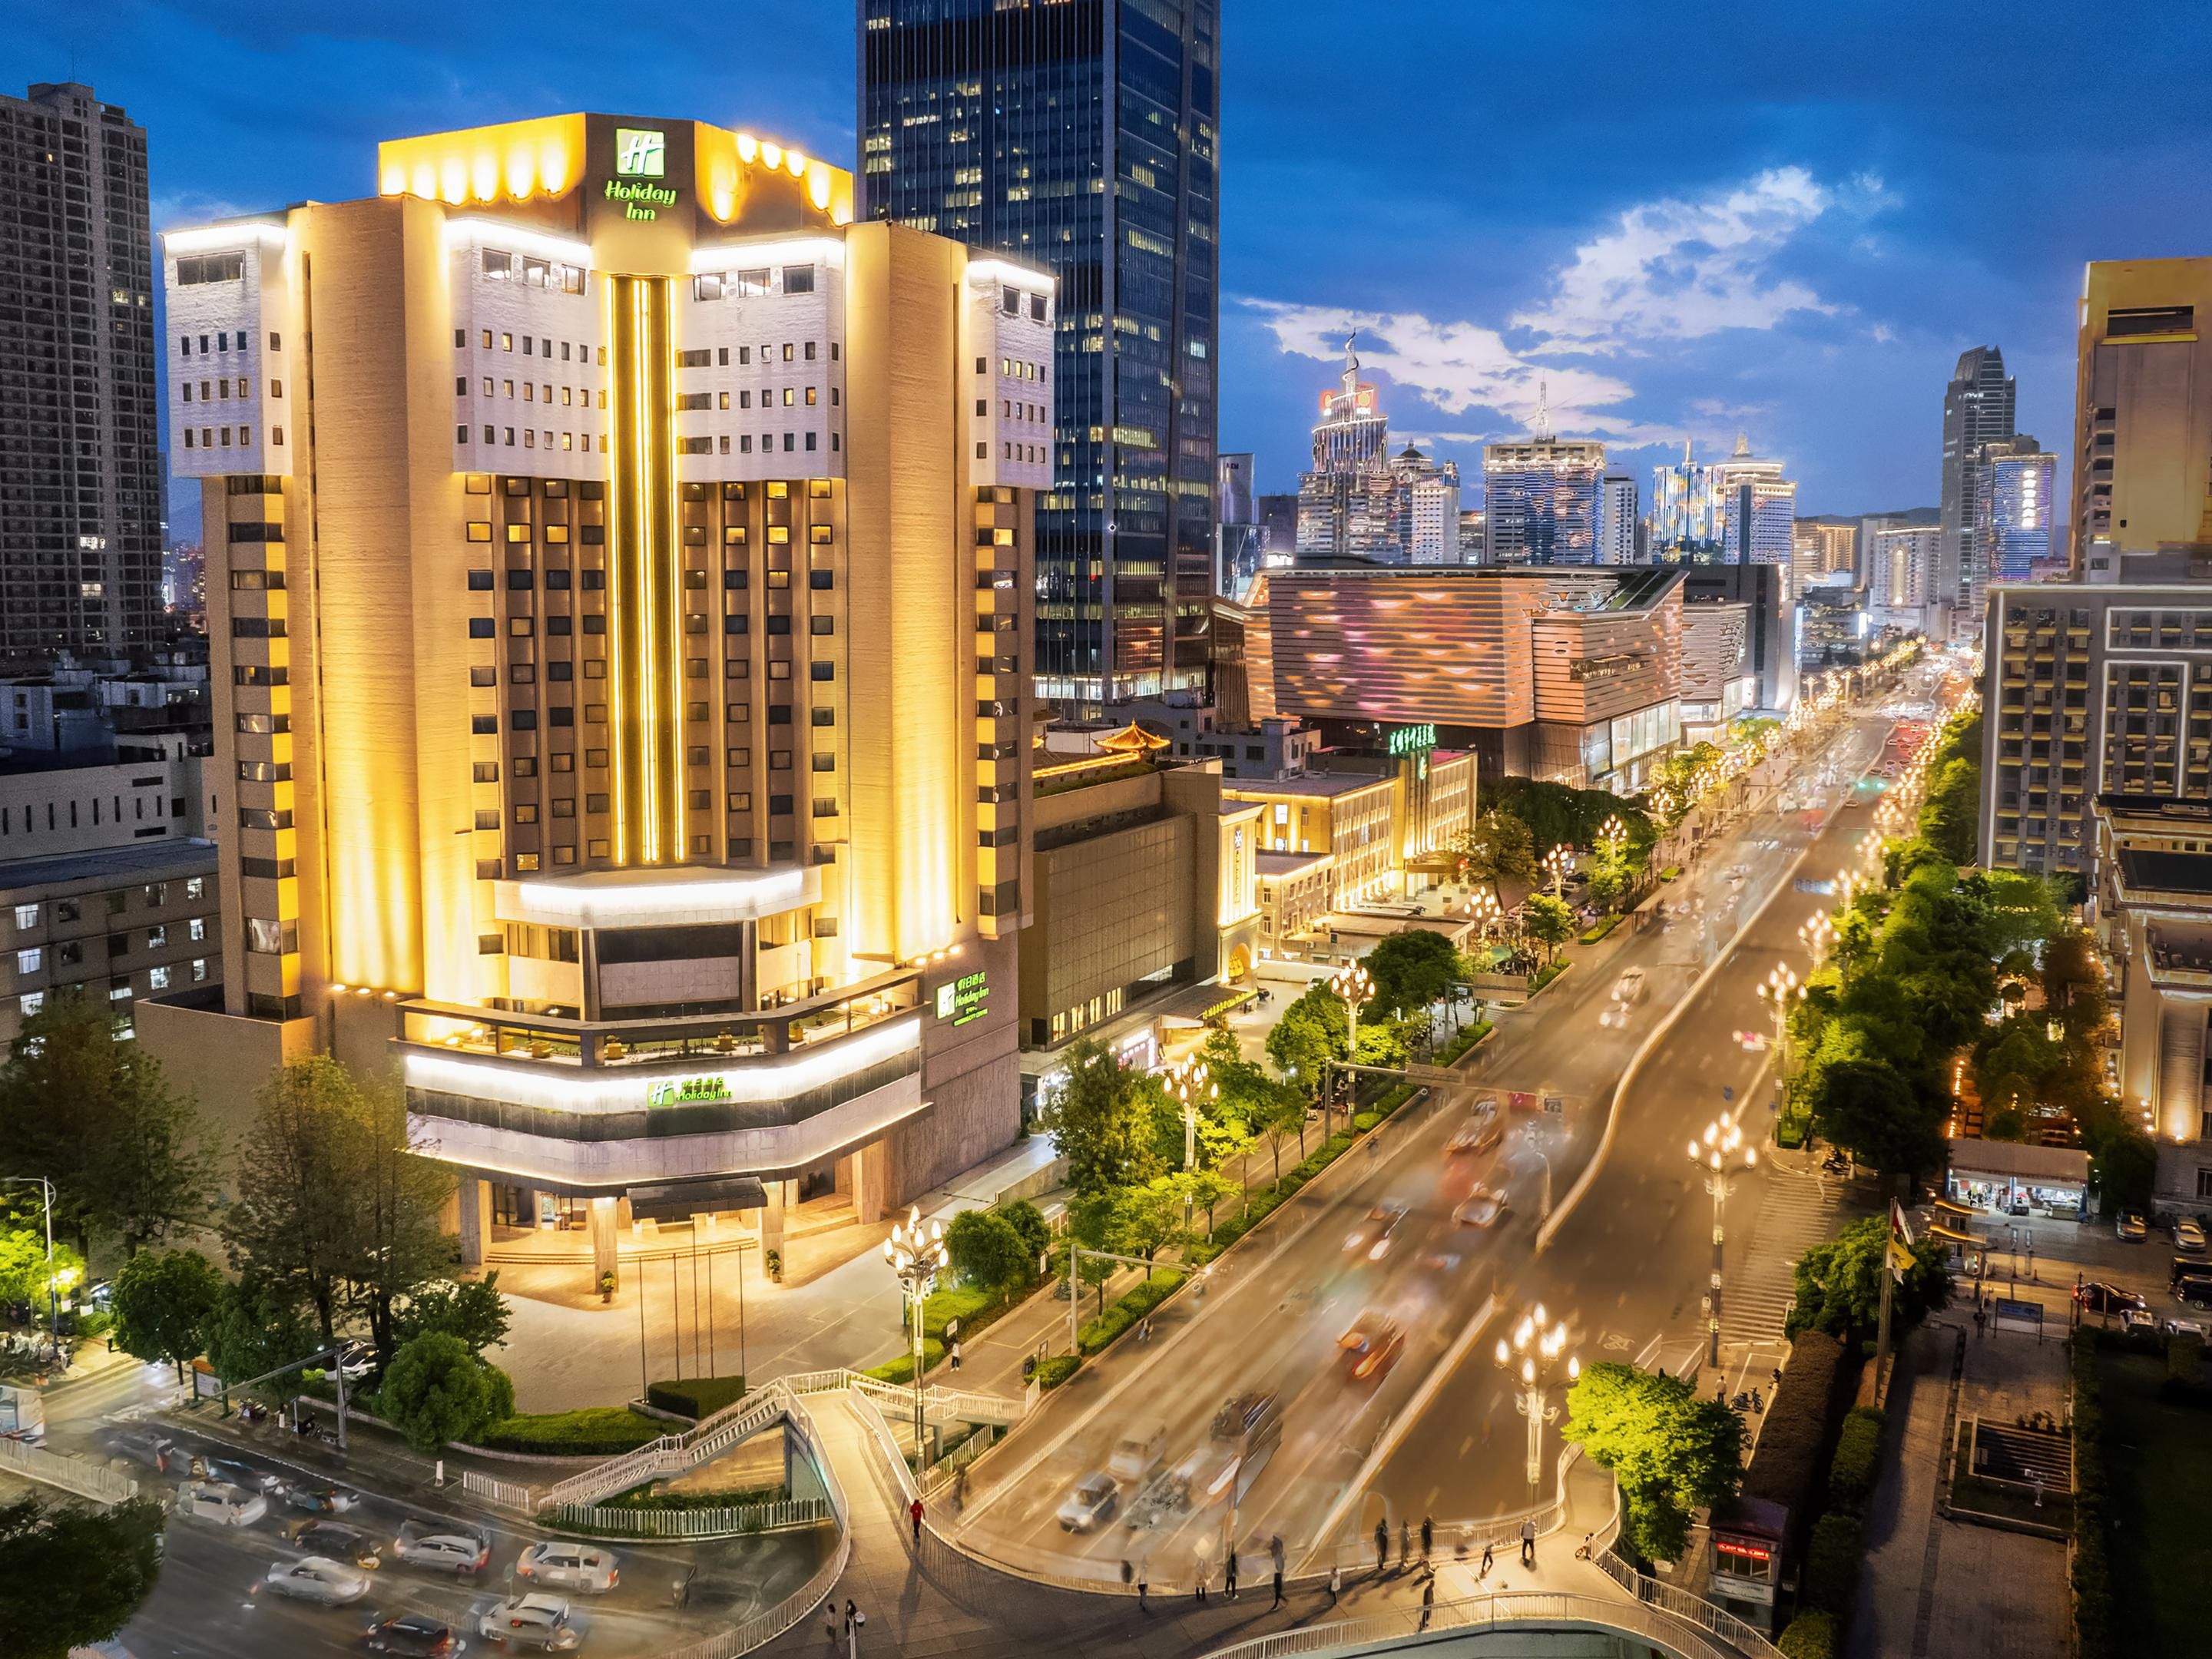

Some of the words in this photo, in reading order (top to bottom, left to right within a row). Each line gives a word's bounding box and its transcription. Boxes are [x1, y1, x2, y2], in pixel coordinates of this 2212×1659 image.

[604, 180, 676, 207] Holiday
[625, 201, 655, 221] Inn
[955, 990, 980, 1008] Holiday
[979, 986, 989, 998] Inn
[676, 1088, 717, 1101] Holiday
[717, 1087, 733, 1098] Inn
